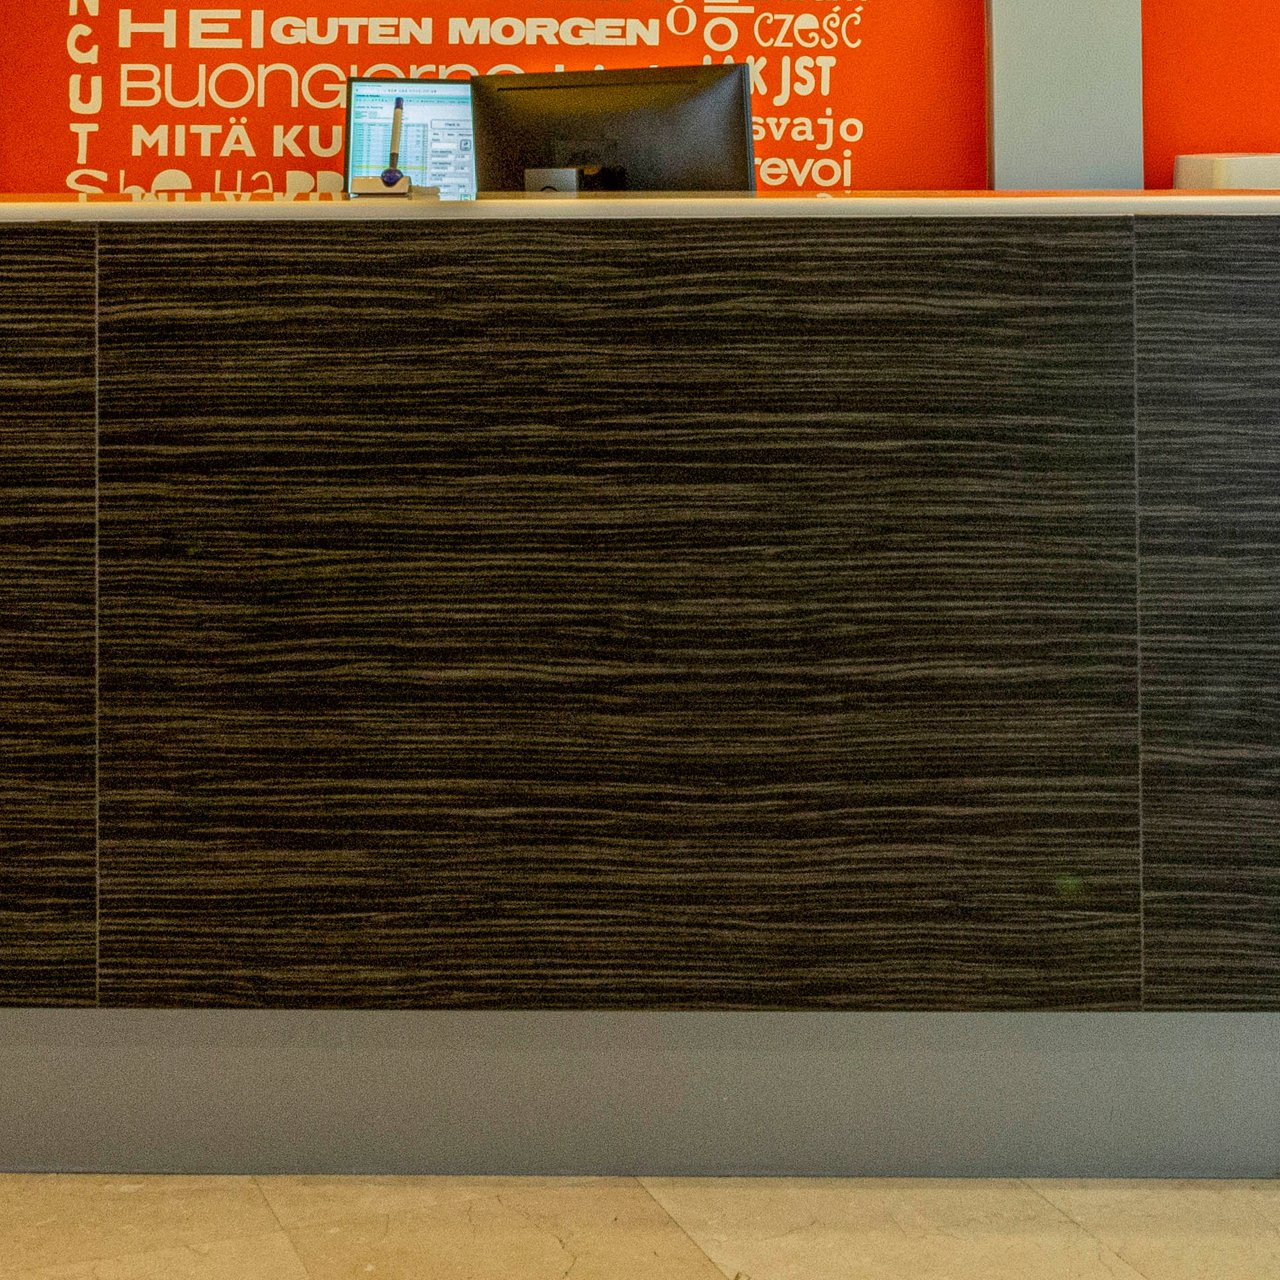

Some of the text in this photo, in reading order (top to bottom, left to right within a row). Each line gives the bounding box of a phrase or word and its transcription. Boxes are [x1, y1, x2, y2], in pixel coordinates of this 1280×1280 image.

[119, 9, 264, 49] HEI
[270, 17, 660, 46] GUTEN MORGEN
[773, 55, 837, 107] JST
[131, 116, 256, 157] MITÄ
